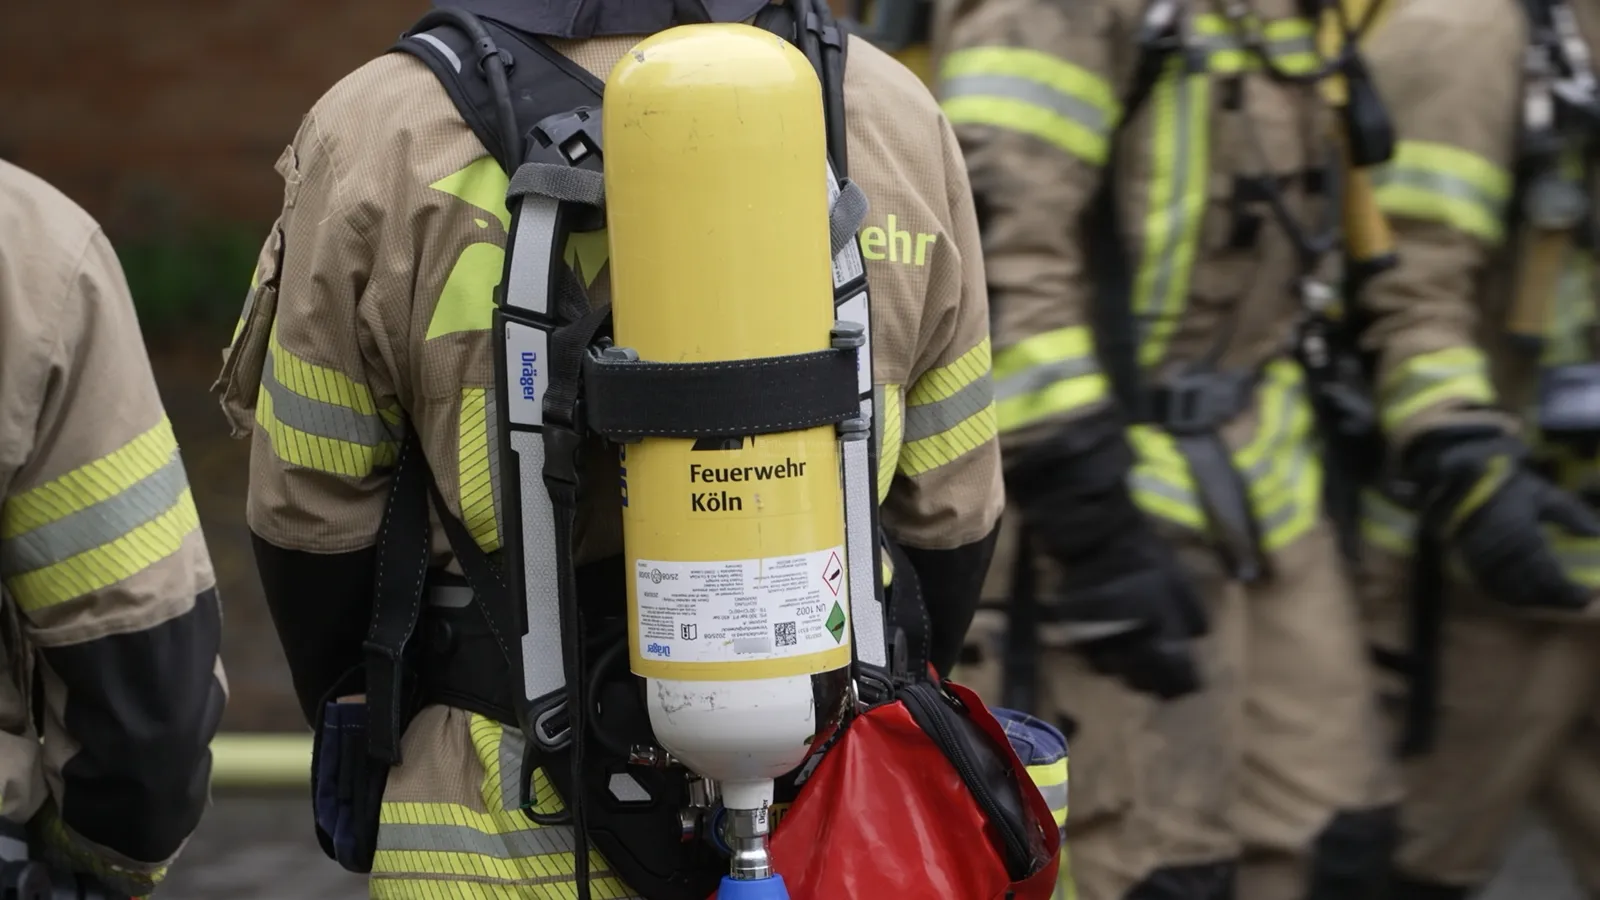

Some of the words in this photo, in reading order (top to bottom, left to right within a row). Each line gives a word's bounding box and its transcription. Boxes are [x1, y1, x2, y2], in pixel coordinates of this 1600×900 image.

[519, 351, 538, 402] Dräger
[691, 458, 805, 482] Feuerwehr
[692, 491, 741, 511] Köln
[796, 606, 813, 616] 1002
[816, 603, 826, 612] UN
[647, 643, 670, 657] Dräger
